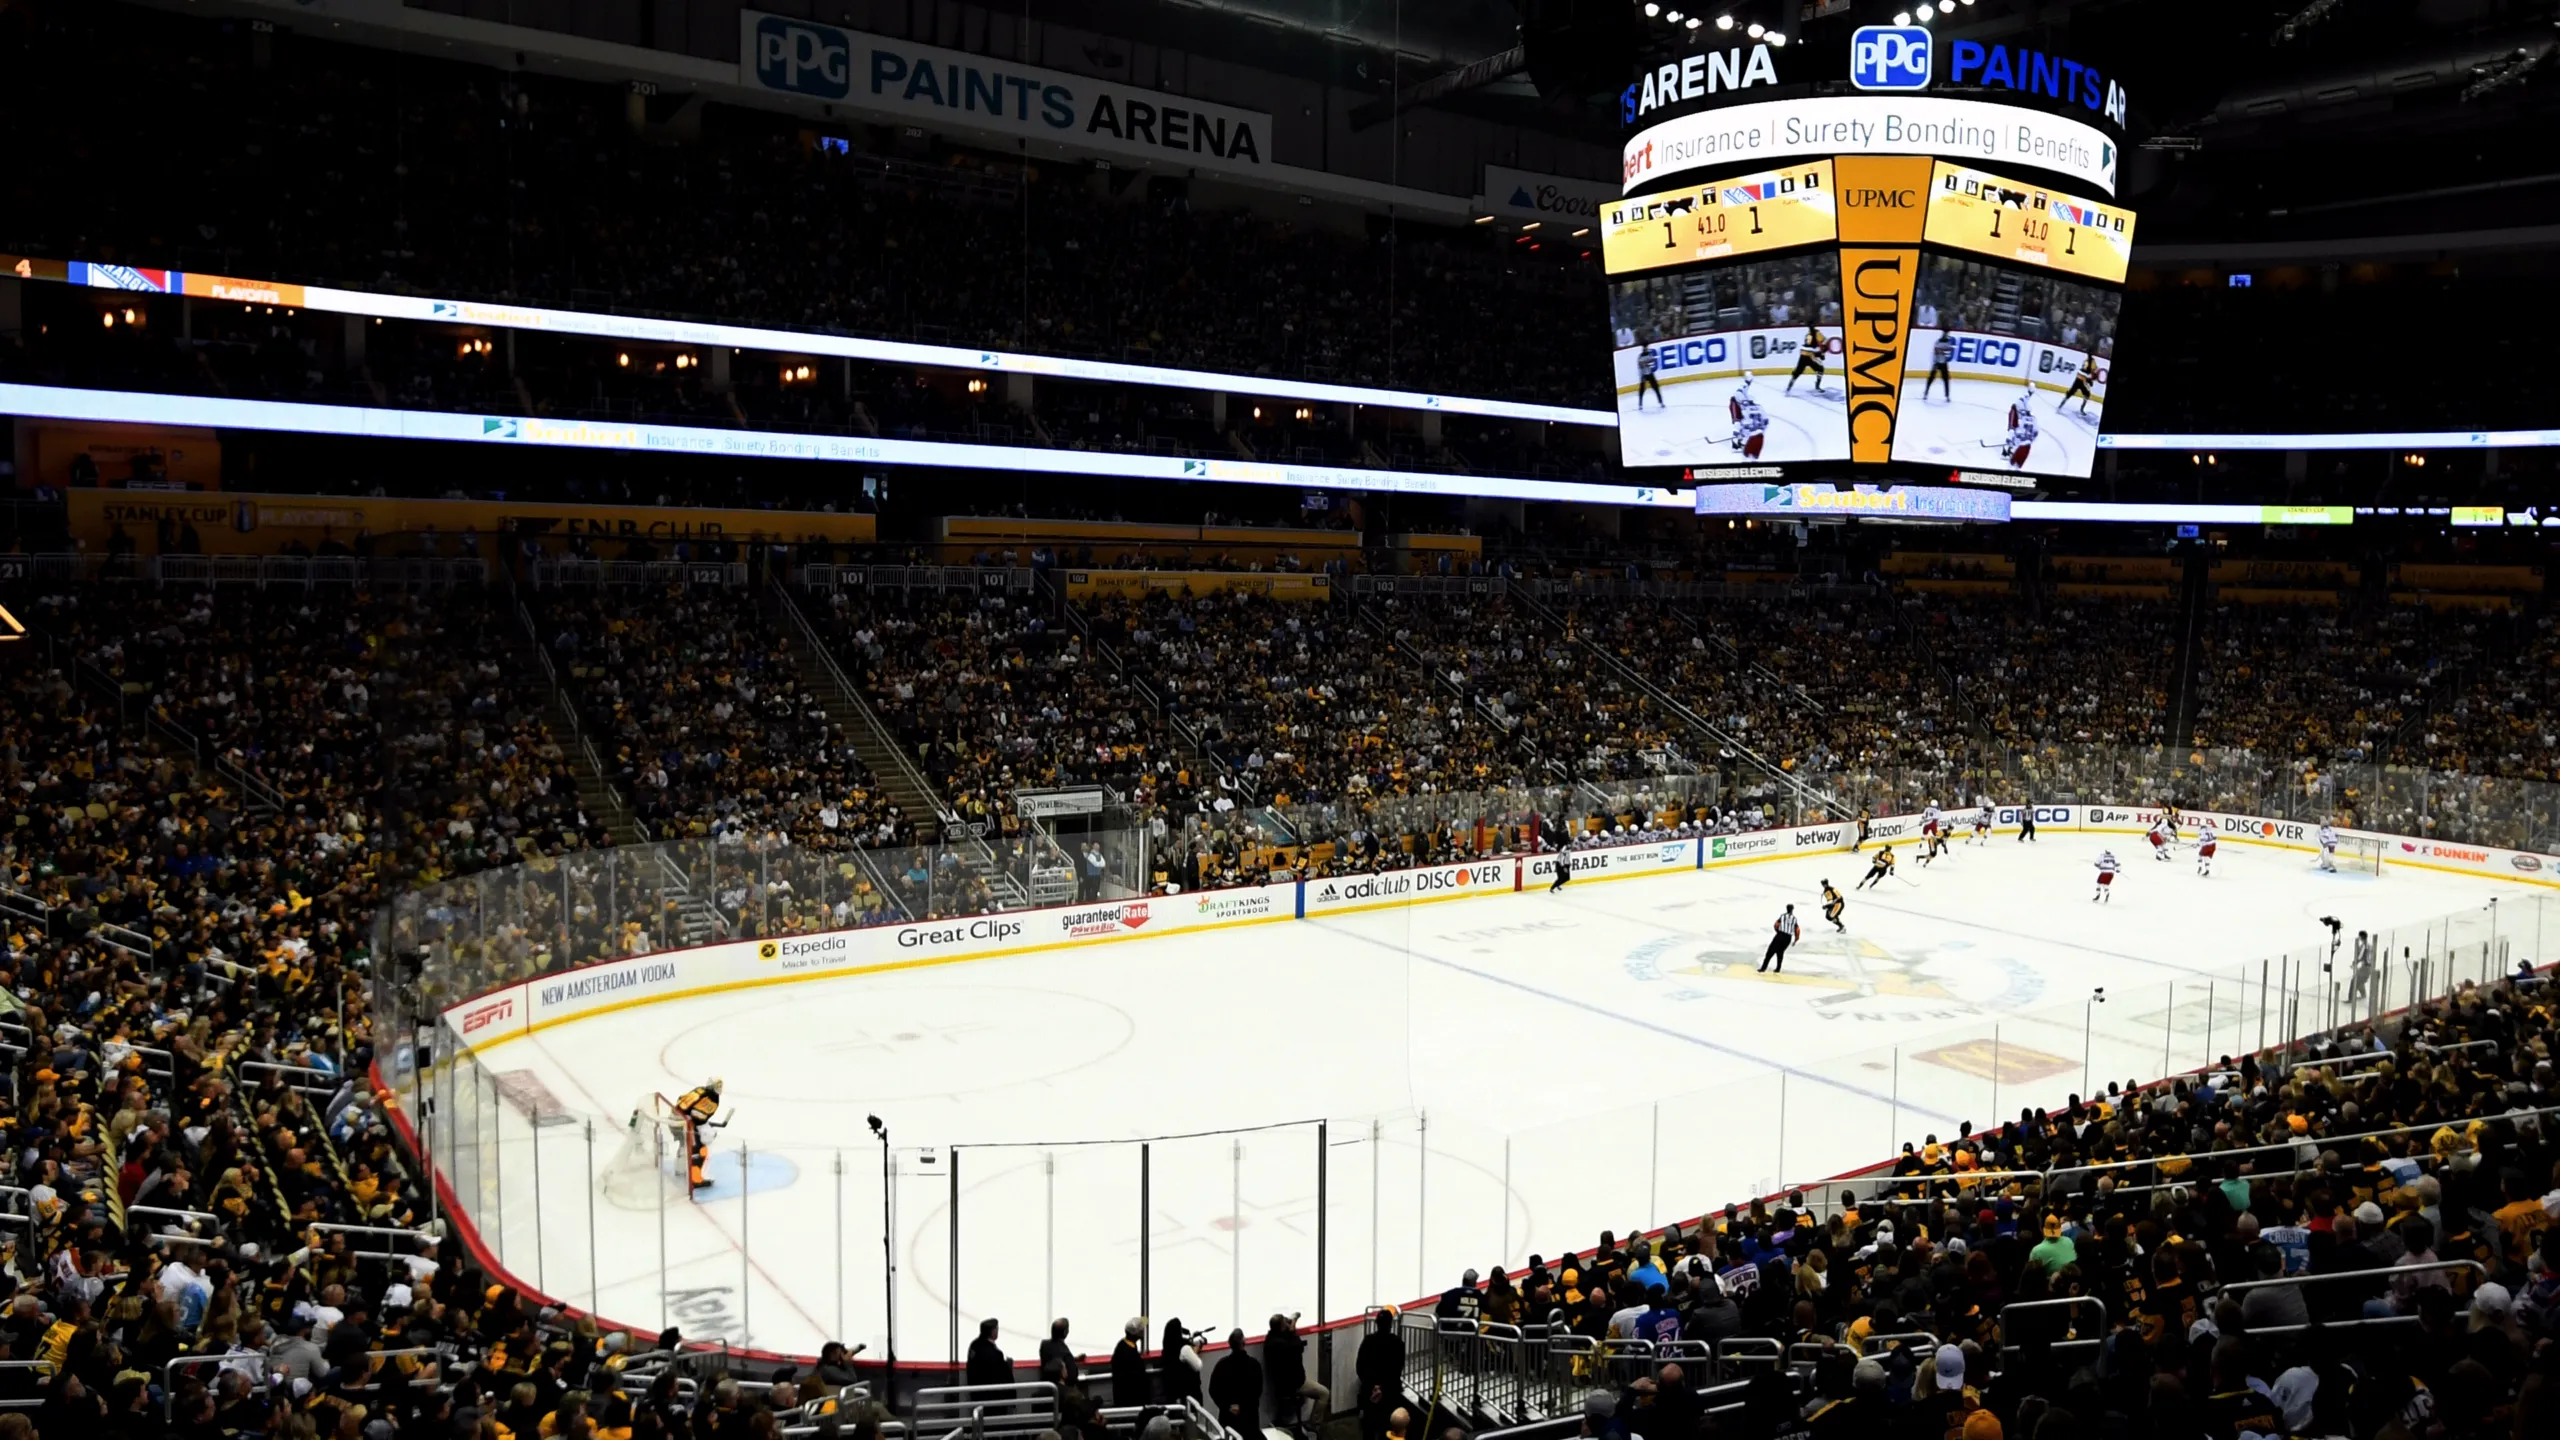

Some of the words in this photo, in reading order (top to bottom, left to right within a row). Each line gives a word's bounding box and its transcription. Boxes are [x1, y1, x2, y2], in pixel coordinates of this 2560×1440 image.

[1856, 33, 1927, 83] PPG
[1638, 43, 1778, 116] ARENA
[1951, 39, 2101, 111] PAINTS
[760, 27, 847, 87] PPG
[870, 48, 1075, 129] PAINTS
[1085, 93, 1260, 165] ARENA
[1660, 127, 1761, 165] Insurance
[1785, 117, 1875, 148] Surety
[1885, 115, 1996, 155] Bonding
[2018, 125, 2090, 169] Benefits
[1536, 184, 1598, 218] Coors
[1845, 188, 1916, 208] UPMC
[1697, 213, 1726, 235] 41.0
[1749, 206, 1763, 234] 1
[1990, 209, 2001, 238] 1
[2023, 218, 2048, 241] 41.0
[1663, 222, 1677, 249] 1
[2065, 227, 2075, 254] 1
[16, 260, 31, 277] 4
[1849, 255, 1901, 444] UPMC
[646, 433, 714, 449] Insurance
[724, 437, 766, 455] Surety
[769, 439, 821, 458] Bonding
[1799, 486, 1907, 510] Seubert
[103, 504, 190, 523] STANLEY
[191, 506, 228, 524] CUP
[693, 569, 720, 583] 122
[841, 571, 864, 584] 101
[983, 573, 1004, 586] 101
[1376, 580, 1394, 592] 103
[1471, 581, 1488, 593] 103
[1553, 583, 1569, 594] 104
[2105, 811, 2130, 823] App
[1795, 829, 1841, 846] betway
[1867, 823, 1902, 839] erizon
[2224, 818, 2304, 841] DISCOVER
[1616, 854, 1631, 863] THE
[1633, 853, 1647, 862] BEST
[1647, 852, 1659, 860] RUN
[1662, 844, 1684, 861] SAP
[1532, 854, 1609, 876] GATRADE
[1345, 875, 1410, 899] adiclub
[1416, 864, 1502, 892] DISCOVER
[1062, 905, 1121, 930] guaranteed
[1123, 905, 1148, 919] Rate
[1216, 905, 1270, 918] SPORTSBOOK
[897, 926, 965, 948] Great
[974, 919, 1021, 941] Clips
[1436, 917, 1581, 944] UPMC
[782, 936, 846, 956] Expedia
[782, 960, 808, 969] Made
[810, 958, 820, 966] to
[821, 954, 846, 965] Travel
[541, 985, 565, 1007] NEW
[567, 969, 638, 1000] AMSTERDAM
[640, 962, 677, 985] VODKA
[463, 998, 513, 1035] ESPN
[2268, 1231, 2307, 1244] CROSBY
[1457, 1305, 1480, 1319] 71
